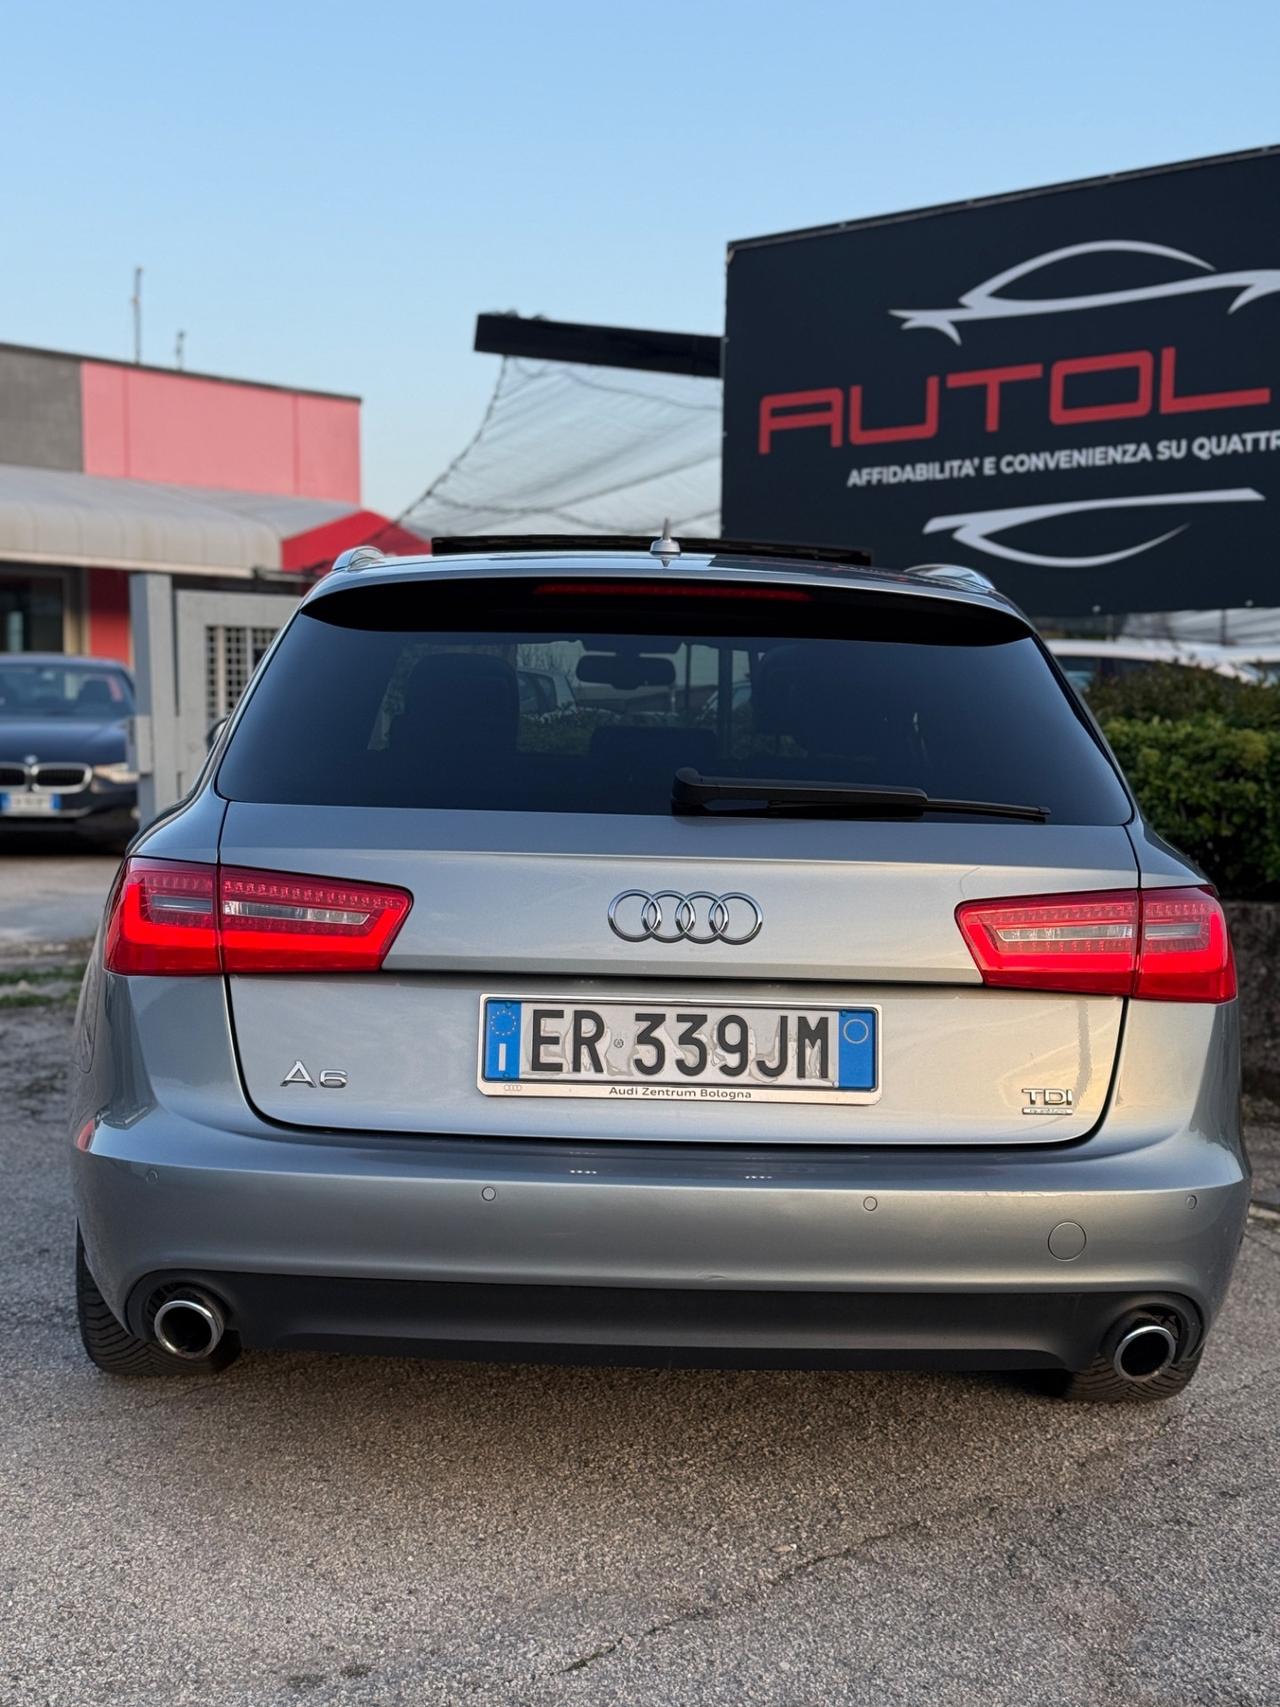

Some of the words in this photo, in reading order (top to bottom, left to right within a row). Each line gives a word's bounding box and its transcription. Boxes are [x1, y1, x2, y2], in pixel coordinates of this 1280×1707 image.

[758, 346, 1271, 454] AUTOL
[846, 456, 980, 488] AFFIDABILITA'
[982, 456, 997, 476] E
[1000, 442, 1153, 475] CONVENIENZA
[1156, 438, 1188, 461] SU
[498, 1043, 507, 1072] I
[280, 1059, 348, 1089] A6
[608, 1086, 639, 1096] Audi
[641, 1087, 697, 1098] Zentrum
[700, 1088, 752, 1100] Bologna
[1021, 1088, 1073, 1106] TDI
